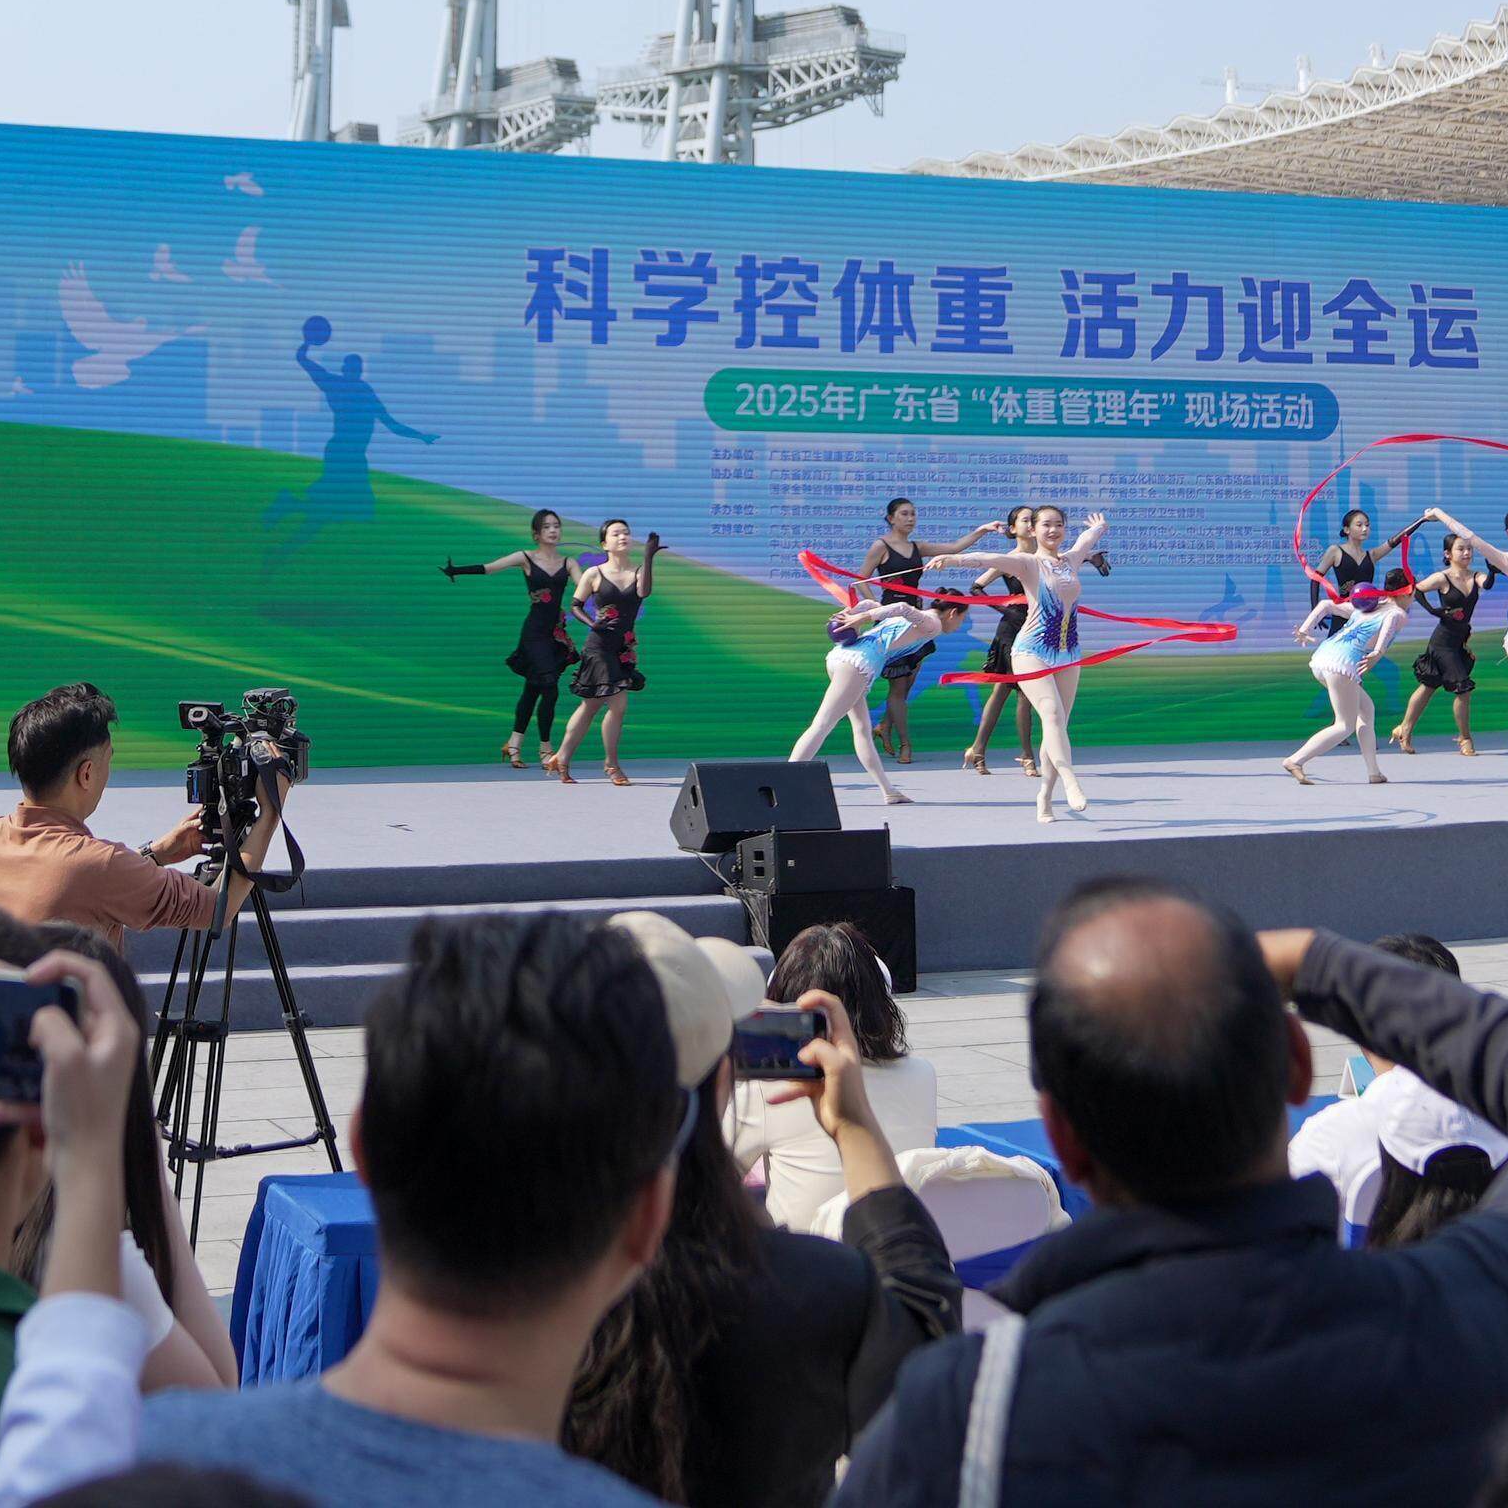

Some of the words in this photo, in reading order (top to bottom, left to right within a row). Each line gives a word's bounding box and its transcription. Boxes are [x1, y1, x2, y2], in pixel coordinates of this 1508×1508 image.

[524, 247, 1014, 355] 科学控体重
[1058, 268, 1480, 370] 活力迎全运
